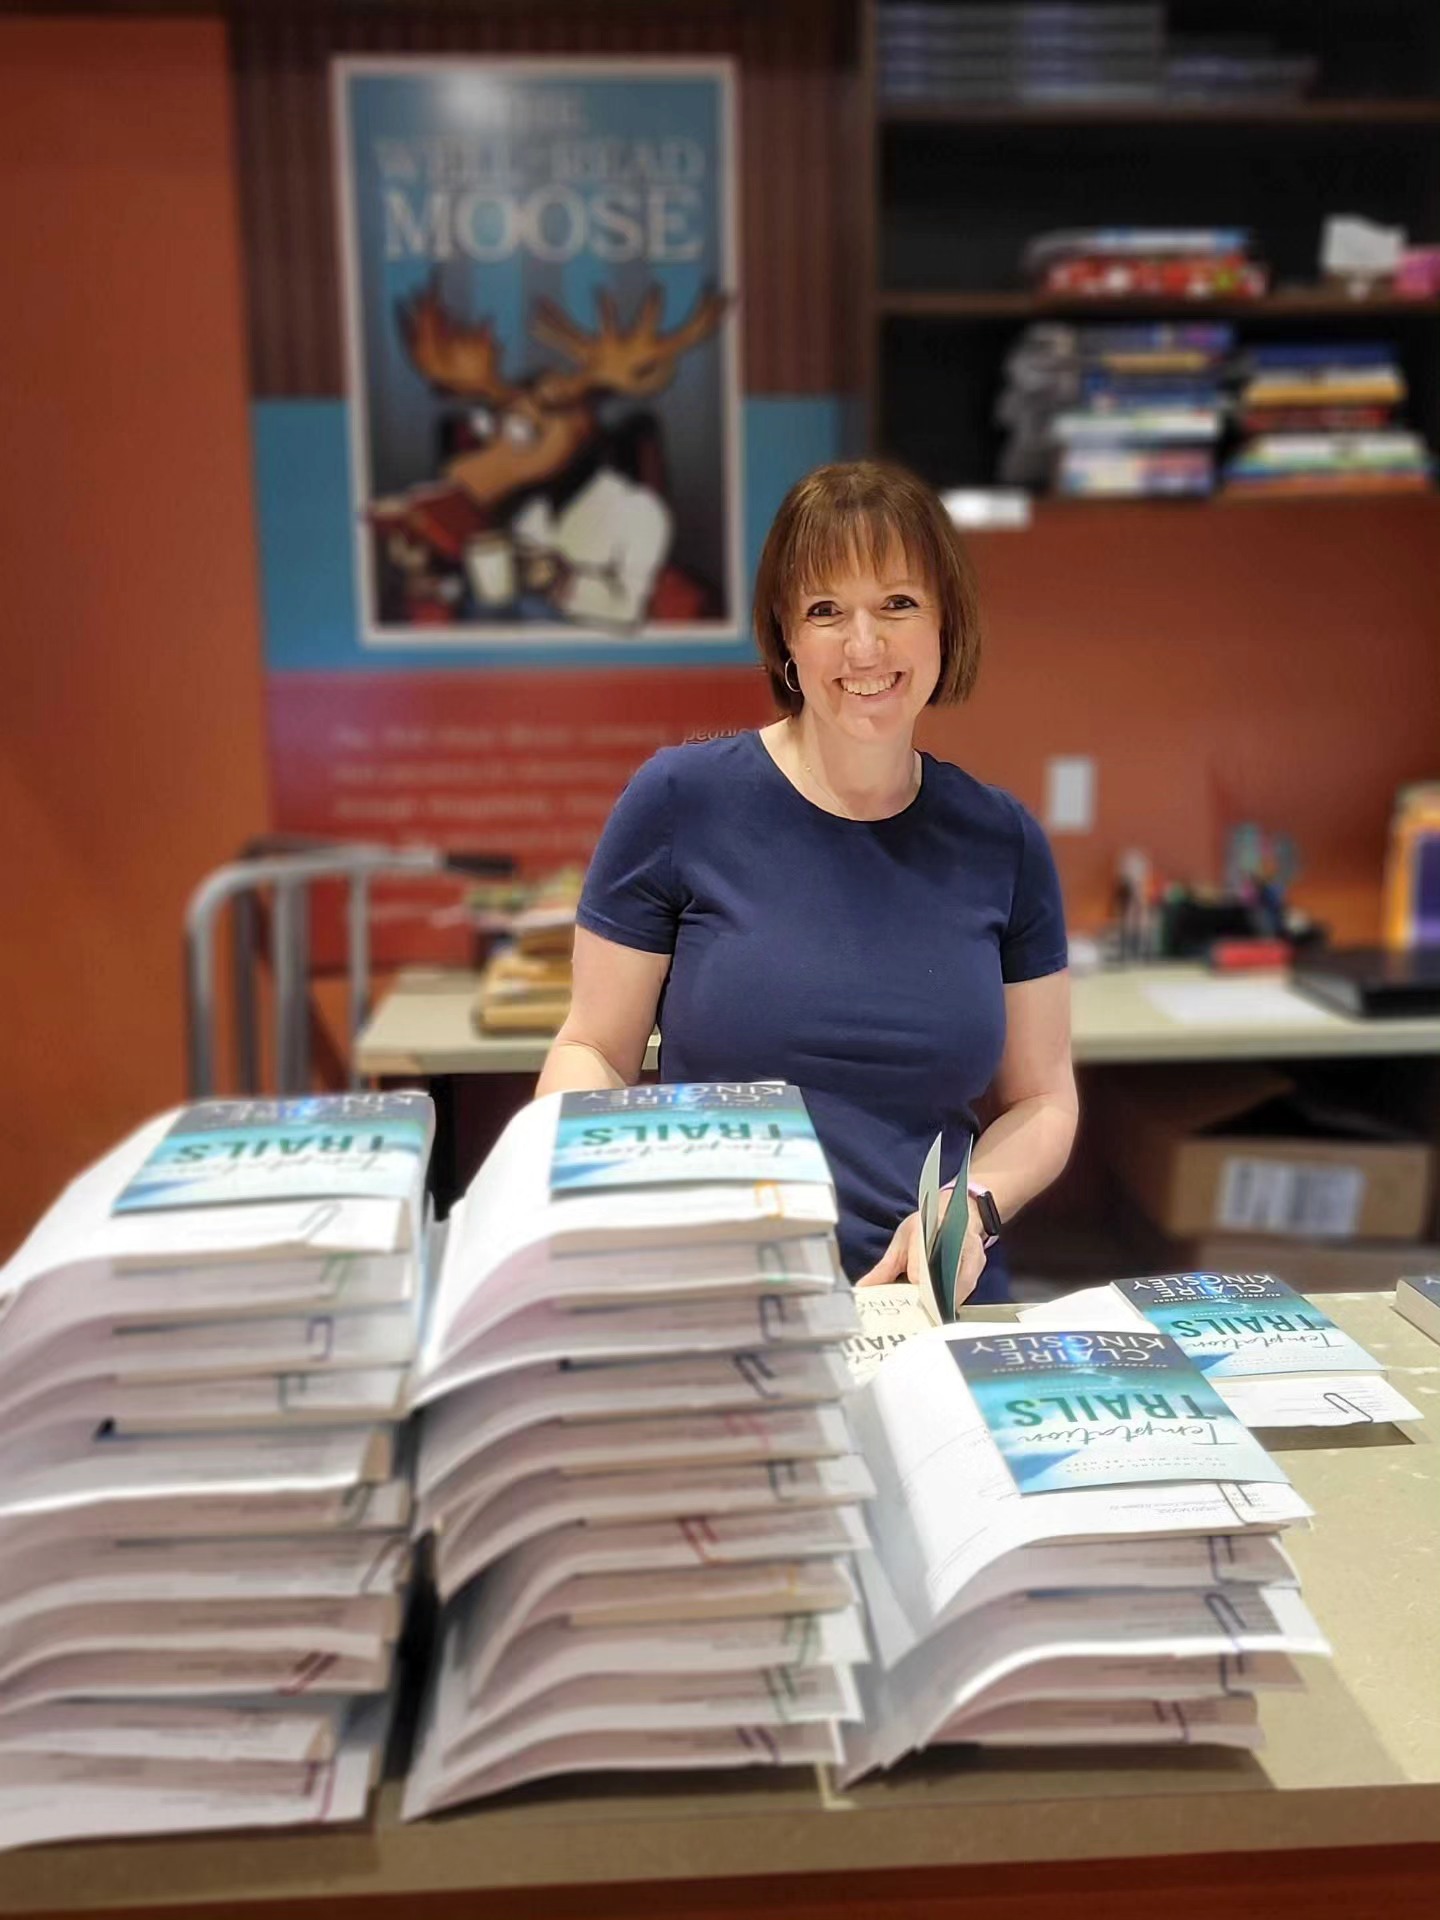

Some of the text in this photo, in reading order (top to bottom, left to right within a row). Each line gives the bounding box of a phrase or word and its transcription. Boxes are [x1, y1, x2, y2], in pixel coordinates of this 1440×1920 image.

[384, 183, 704, 263] MOOSE
[582, 1122, 782, 1147] TRAILS
[172, 1134, 385, 1165] TRAILS
[1133, 1273, 1275, 1290] KINGSLEY
[1154, 1284, 1266, 1298] CLAIRE
[1170, 1312, 1326, 1338] TRAILS
[971, 1334, 1167, 1354] KINGSLEY
[1186, 1332, 1345, 1350] Temptation
[1004, 1348, 1150, 1366] CLAIRE
[1004, 1392, 1219, 1428] TRAILS
[1017, 1420, 1240, 1446] Temptation
